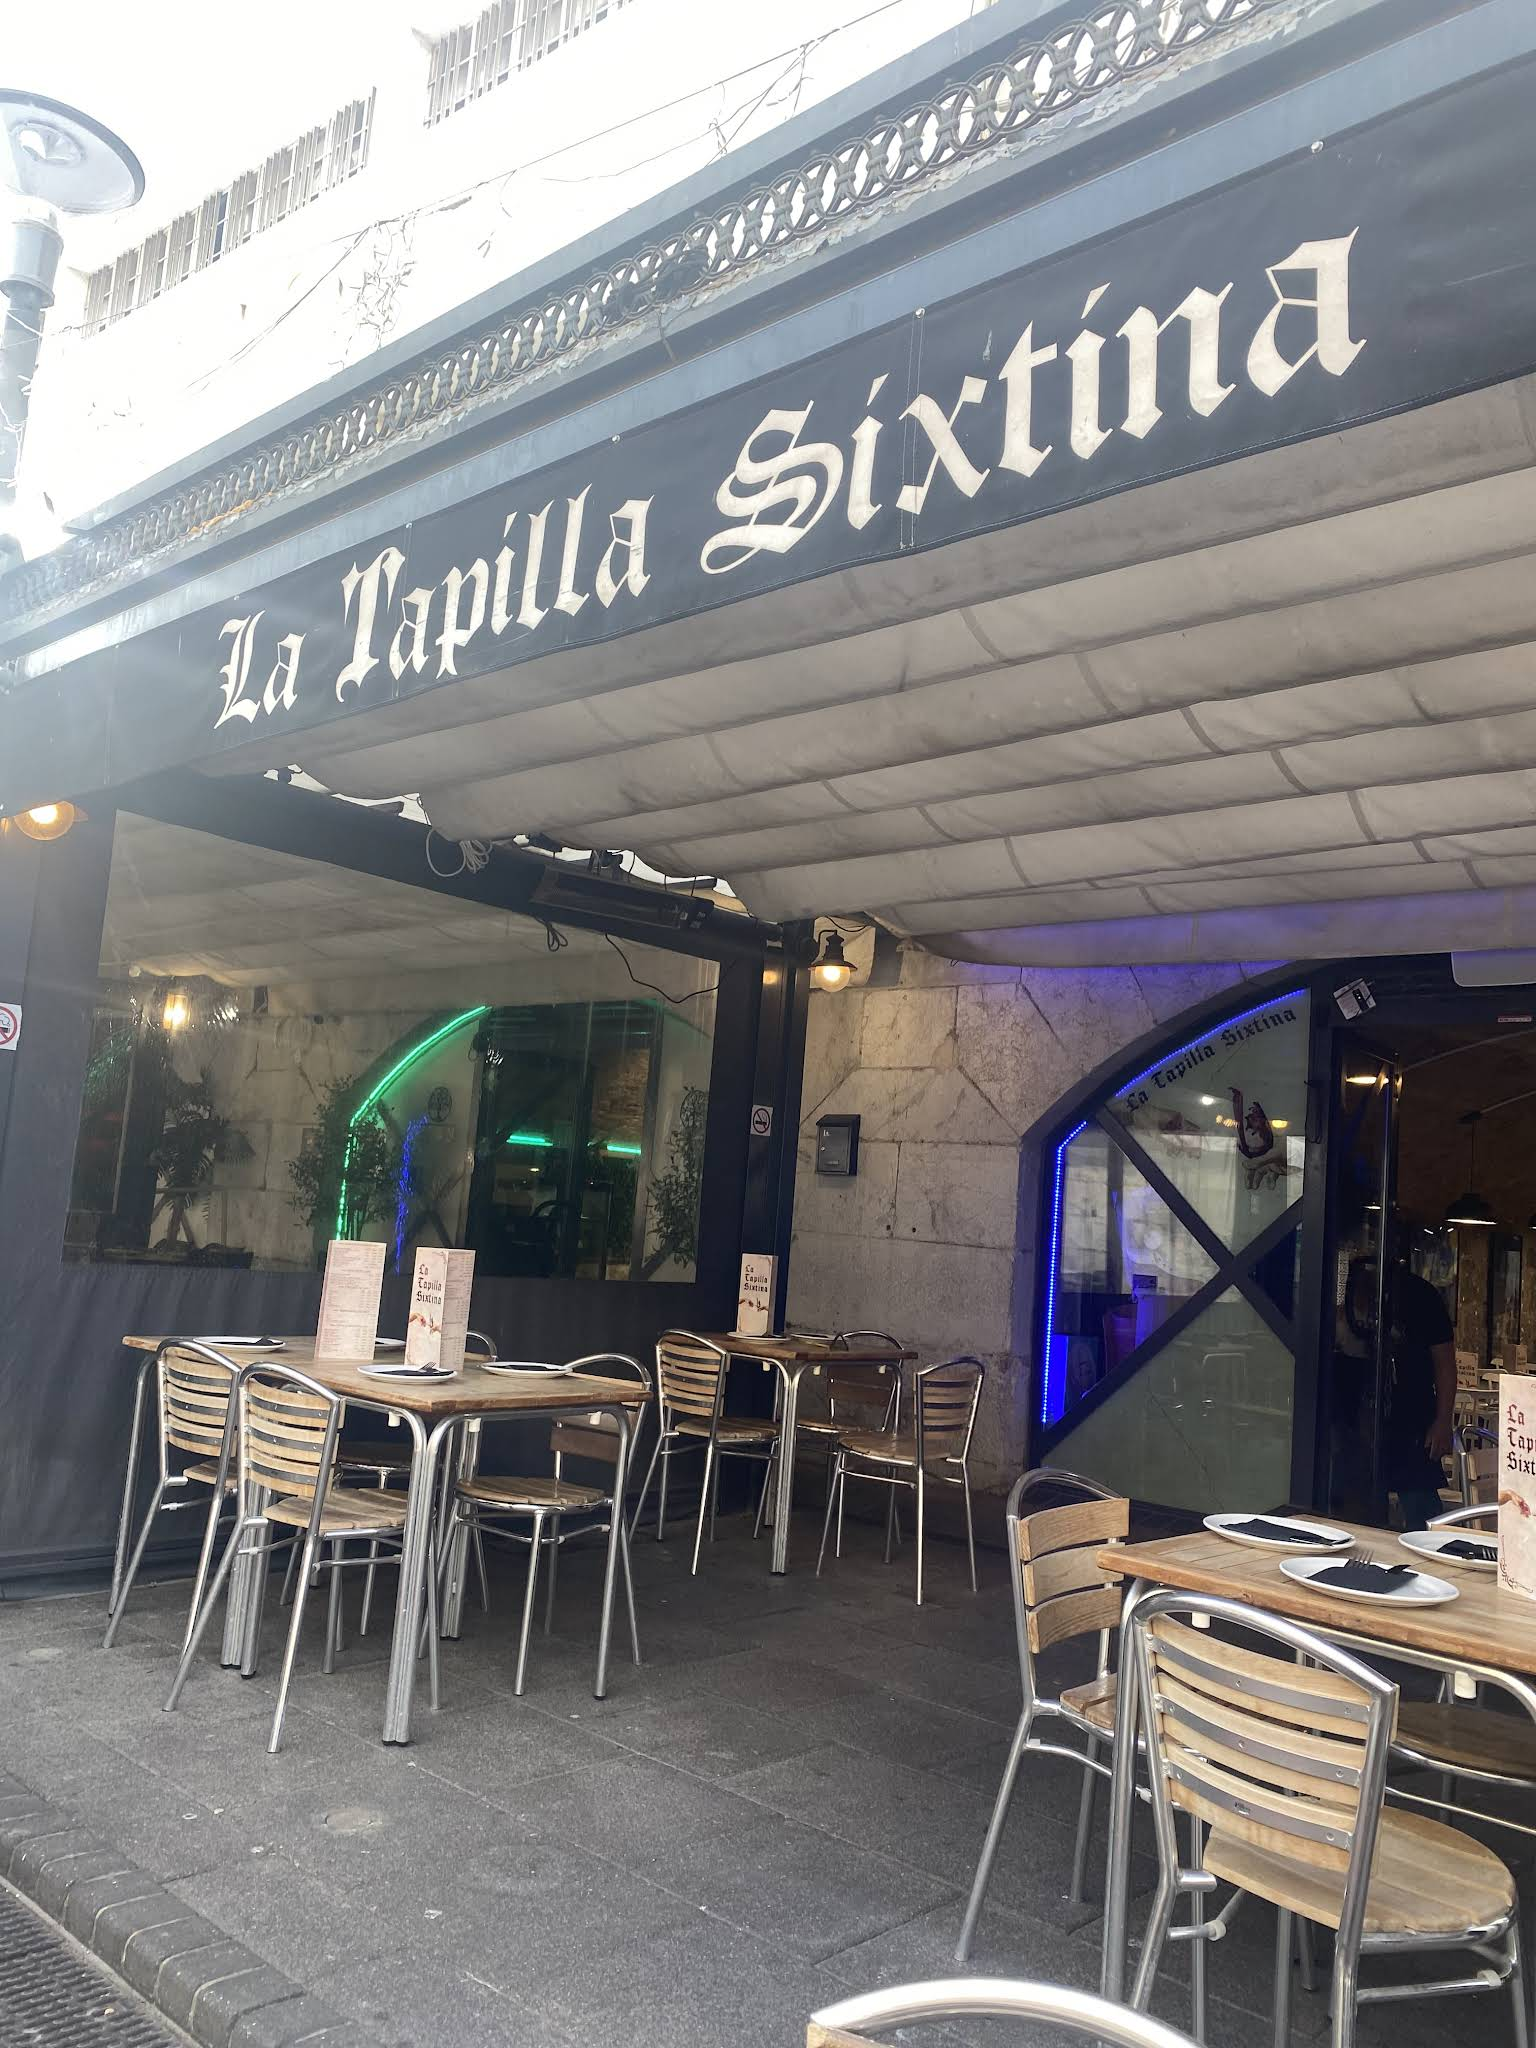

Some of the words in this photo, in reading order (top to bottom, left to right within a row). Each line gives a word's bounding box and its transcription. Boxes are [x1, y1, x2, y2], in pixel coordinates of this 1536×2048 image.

[214, 610, 306, 729] La
[336, 483, 654, 702] Tapilla
[700, 226, 1367, 575] Sixtina
[1125, 1092, 1149, 1112] La
[1151, 1043, 1216, 1089] Tapilla
[1220, 1007, 1297, 1047] Sixtina
[419, 1264, 428, 1275] La
[418, 1277, 441, 1291] Tapilla
[745, 1273, 767, 1283] Tapilla
[744, 1283, 767, 1292] Sixtina
[416, 1291, 441, 1304] Sixtina
[1507, 1404, 1524, 1425] La
